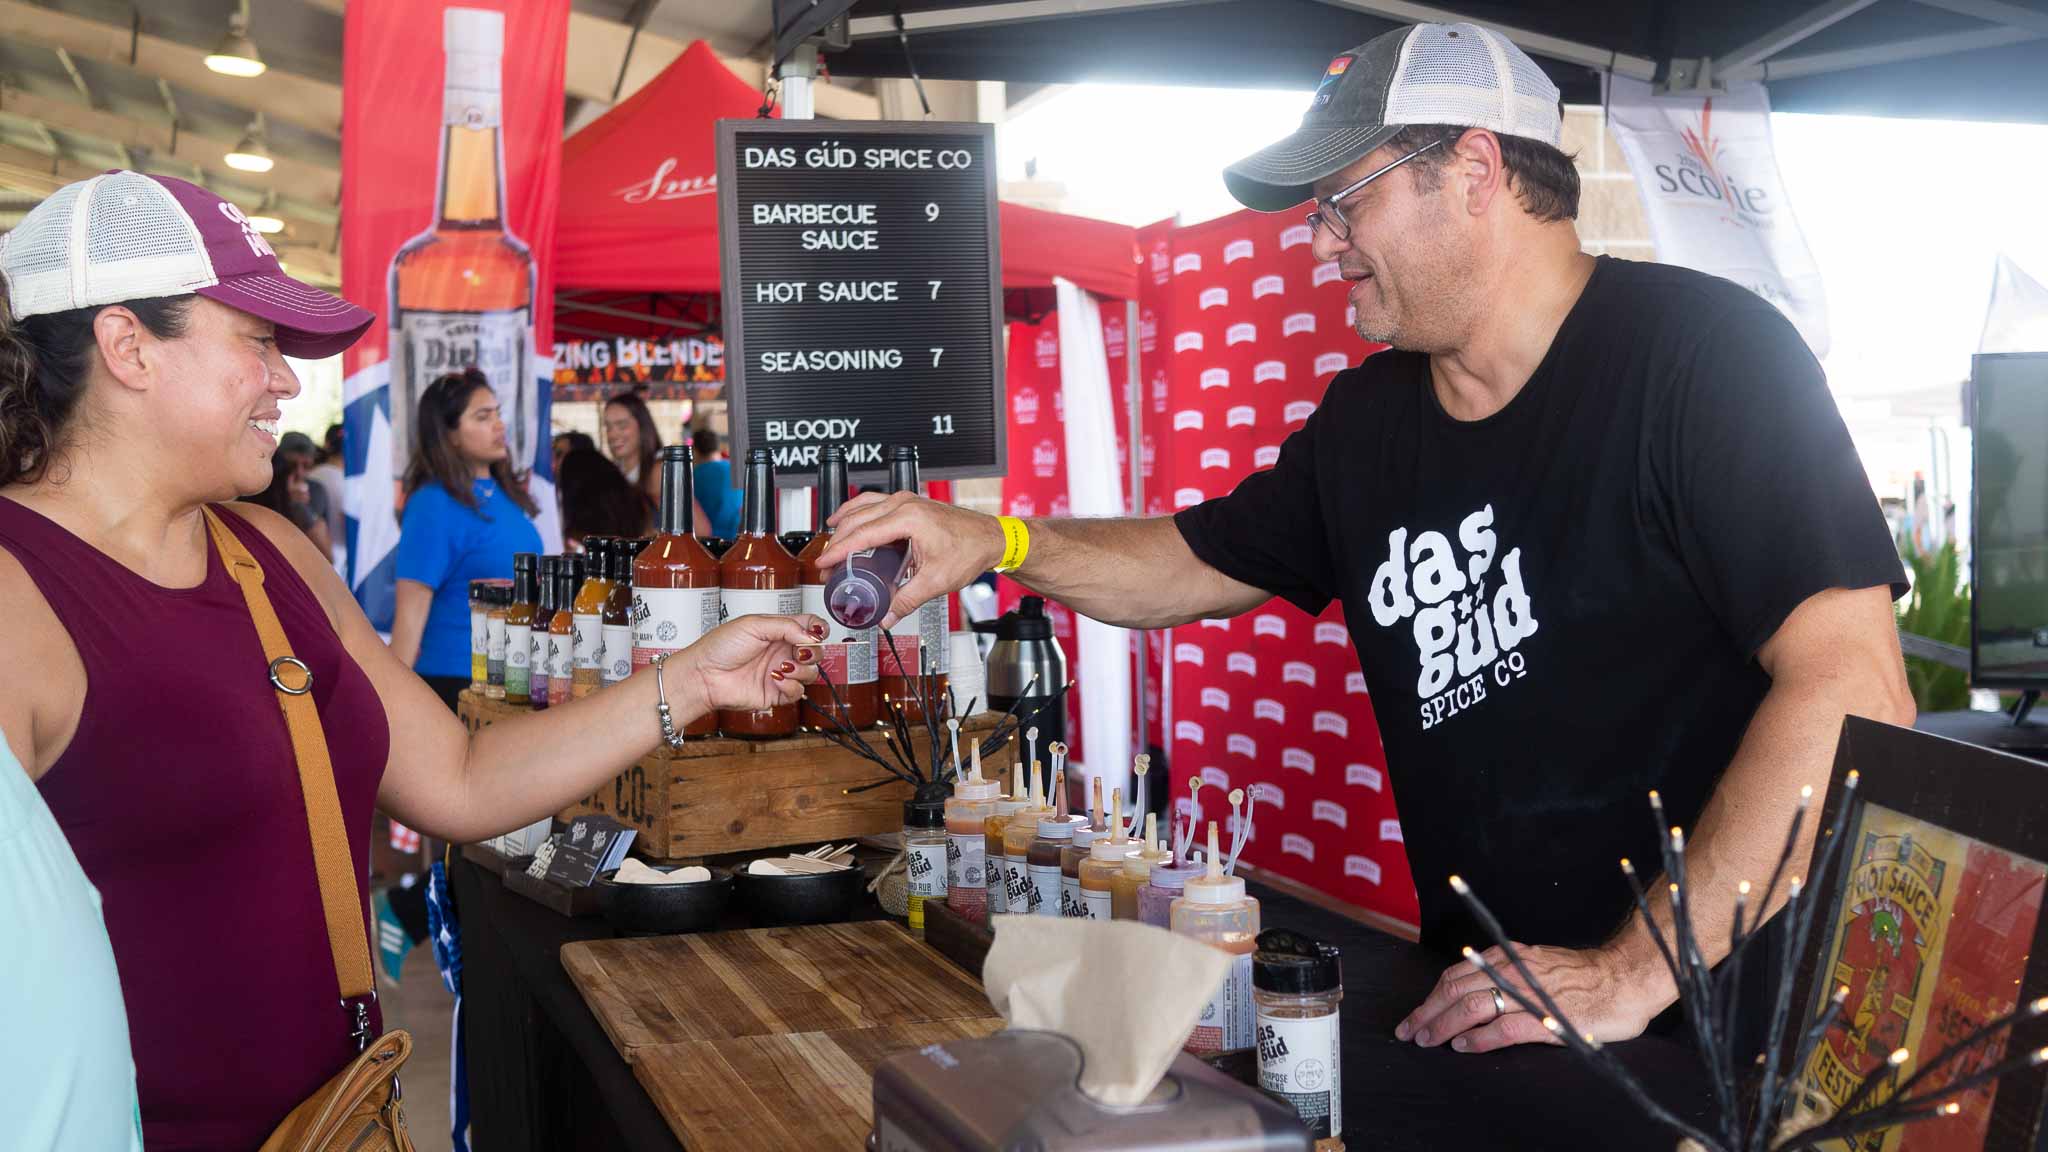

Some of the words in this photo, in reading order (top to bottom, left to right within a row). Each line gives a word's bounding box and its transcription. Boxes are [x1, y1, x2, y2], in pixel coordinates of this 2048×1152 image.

[745, 147, 796, 169] DAS
[864, 149, 933, 169] SPICE
[938, 150, 972, 169] CO
[753, 203, 878, 225] BARBECUE
[925, 203, 940, 222] 9
[801, 230, 879, 250] SAUCE
[756, 283, 807, 303] HOT
[818, 281, 899, 301] SAUCE
[927, 281, 942, 299] 7
[760, 350, 903, 372] SEASONING
[930, 348, 944, 368] 7
[766, 418, 861, 441] BLOODY
[932, 415, 955, 435] 11
[773, 445, 821, 467] MAR
[1368, 503, 1497, 627] das
[1420, 674, 1487, 730] SPICE
[1004, 867, 1019, 884] as
[918, 882, 932, 892] RUB
[1857, 866, 1888, 896] HOT
[1889, 867, 1934, 929] SAUCE
[1258, 1024, 1275, 1043] as
